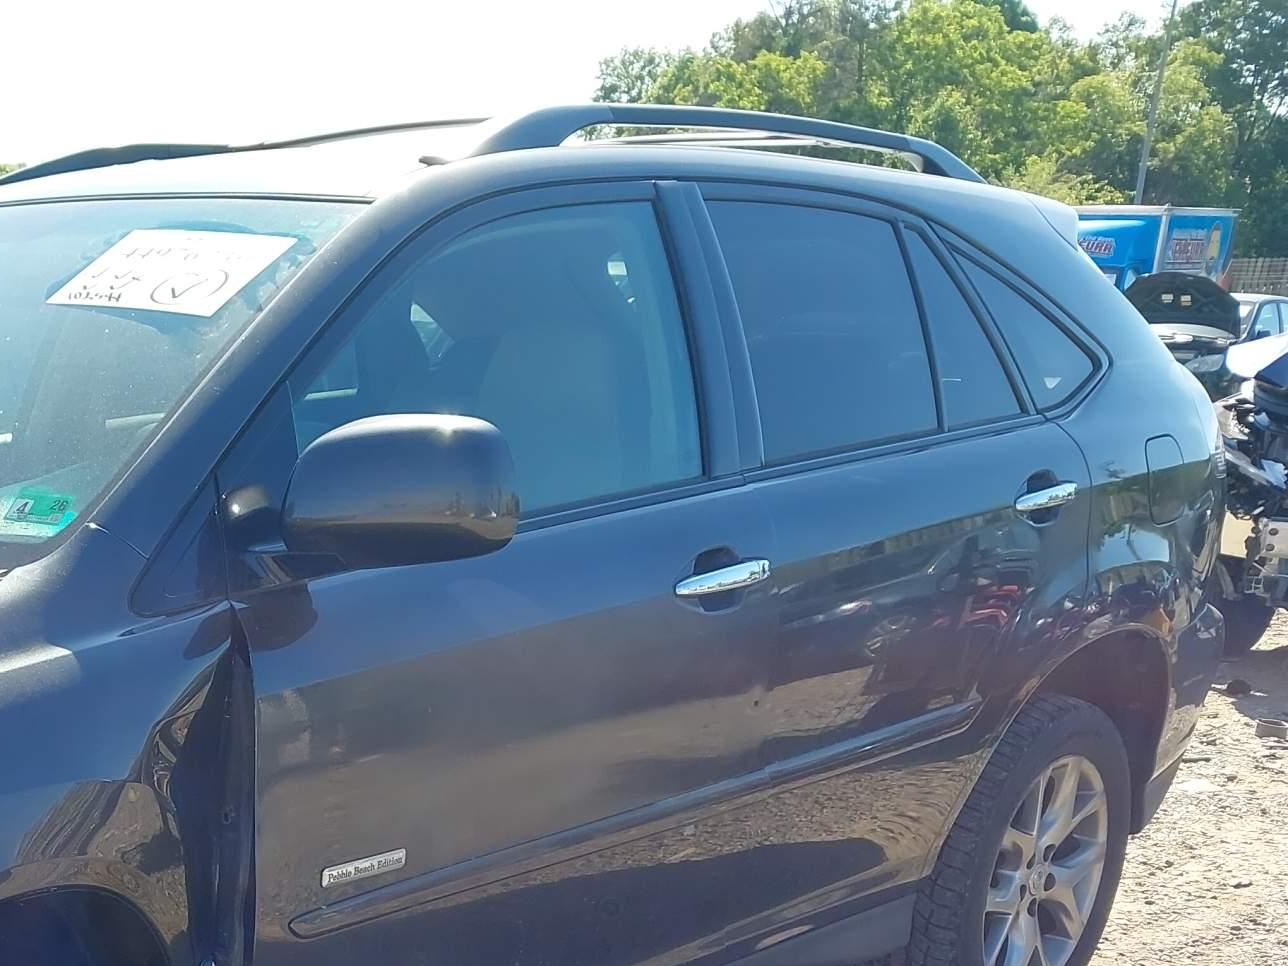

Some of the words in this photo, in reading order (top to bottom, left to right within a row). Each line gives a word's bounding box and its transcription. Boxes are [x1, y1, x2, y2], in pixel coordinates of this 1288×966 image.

[16, 501, 30, 513] 4
[327, 869, 353, 883] Pebble
[354, 863, 375, 876] Beach
[377, 857, 403, 869] Edition
